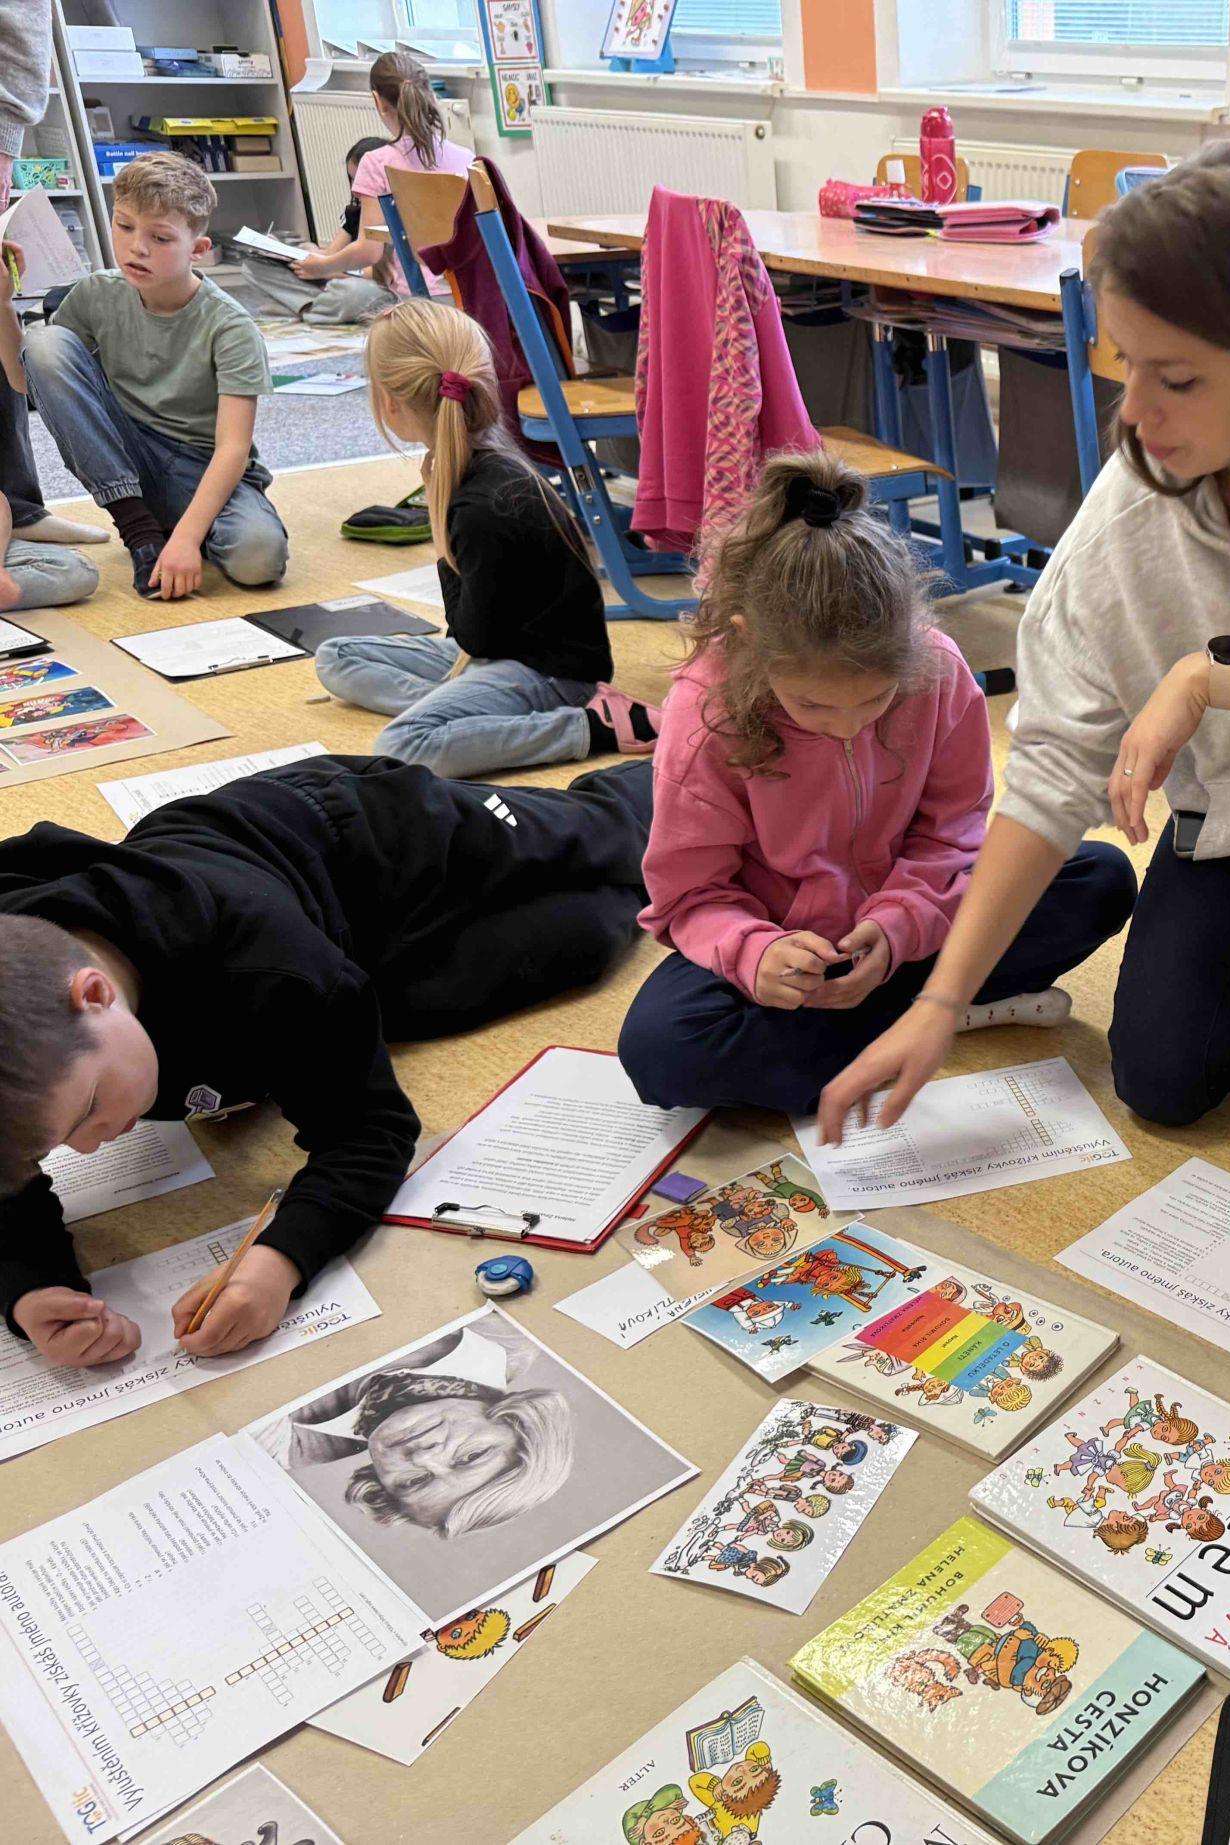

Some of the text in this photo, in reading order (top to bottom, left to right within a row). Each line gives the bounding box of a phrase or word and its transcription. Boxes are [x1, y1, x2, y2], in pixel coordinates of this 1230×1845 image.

[1096, 1248, 1140, 1271] autora.
[1136, 1268, 1180, 1292] jméno
[1174, 1288, 1216, 1312] získáš
[0, 1301, 341, 1433] Vyluště získáš jméno auto
[916, 1545, 965, 1589] HELENA
[9, 1610, 51, 1649] jméno
[31, 1646, 71, 1685] získáš
[52, 1681, 106, 1737] křížovky
[1047, 1690, 1116, 1751] CESTA
[1036, 1673, 1169, 1798] HONZÍKOVA
[85, 1732, 149, 1811] Vyluštěním
[618, 1760, 655, 1791] ALTER
